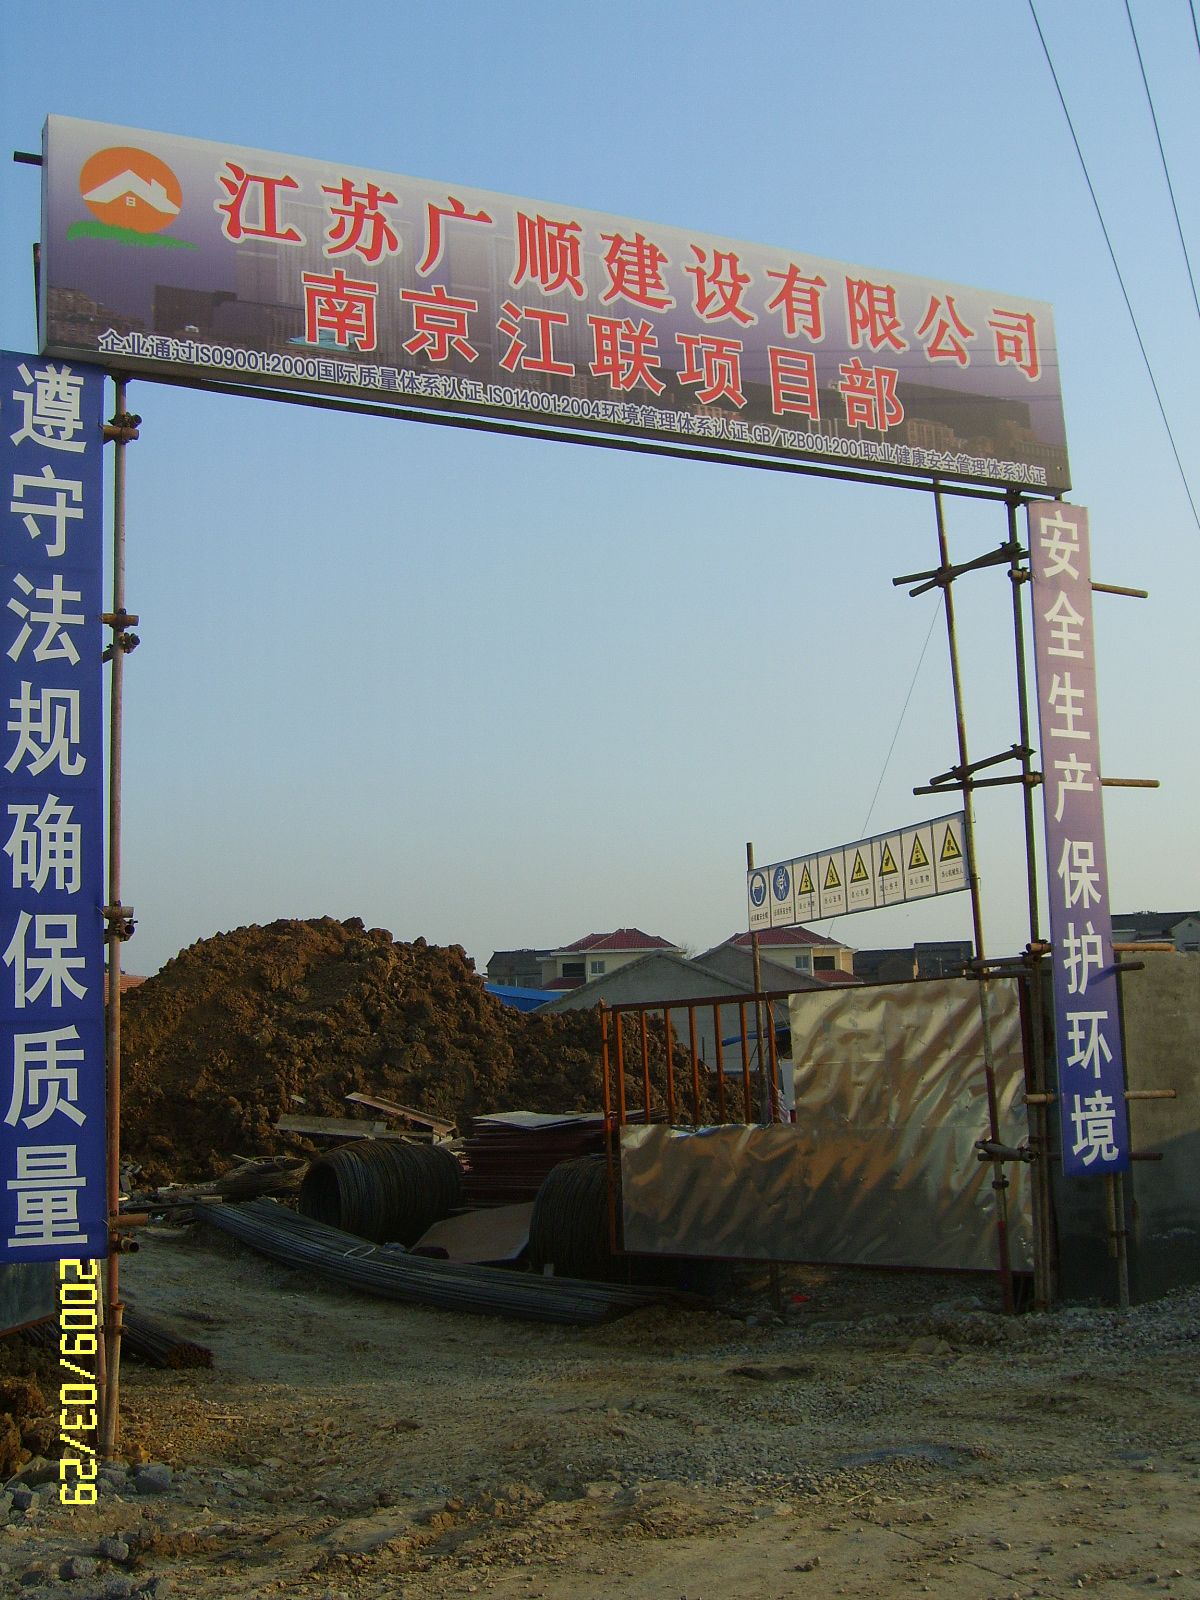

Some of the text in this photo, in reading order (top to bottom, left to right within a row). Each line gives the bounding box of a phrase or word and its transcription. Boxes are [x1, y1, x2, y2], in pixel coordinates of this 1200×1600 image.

[218, 161, 1039, 378] 江苏广顺建设有限公司
[302, 269, 904, 431] 南京江联项目部
[3, 363, 88, 1248] 遵守法规确保质量
[1039, 509, 1120, 1166] 安全生产保护环境
